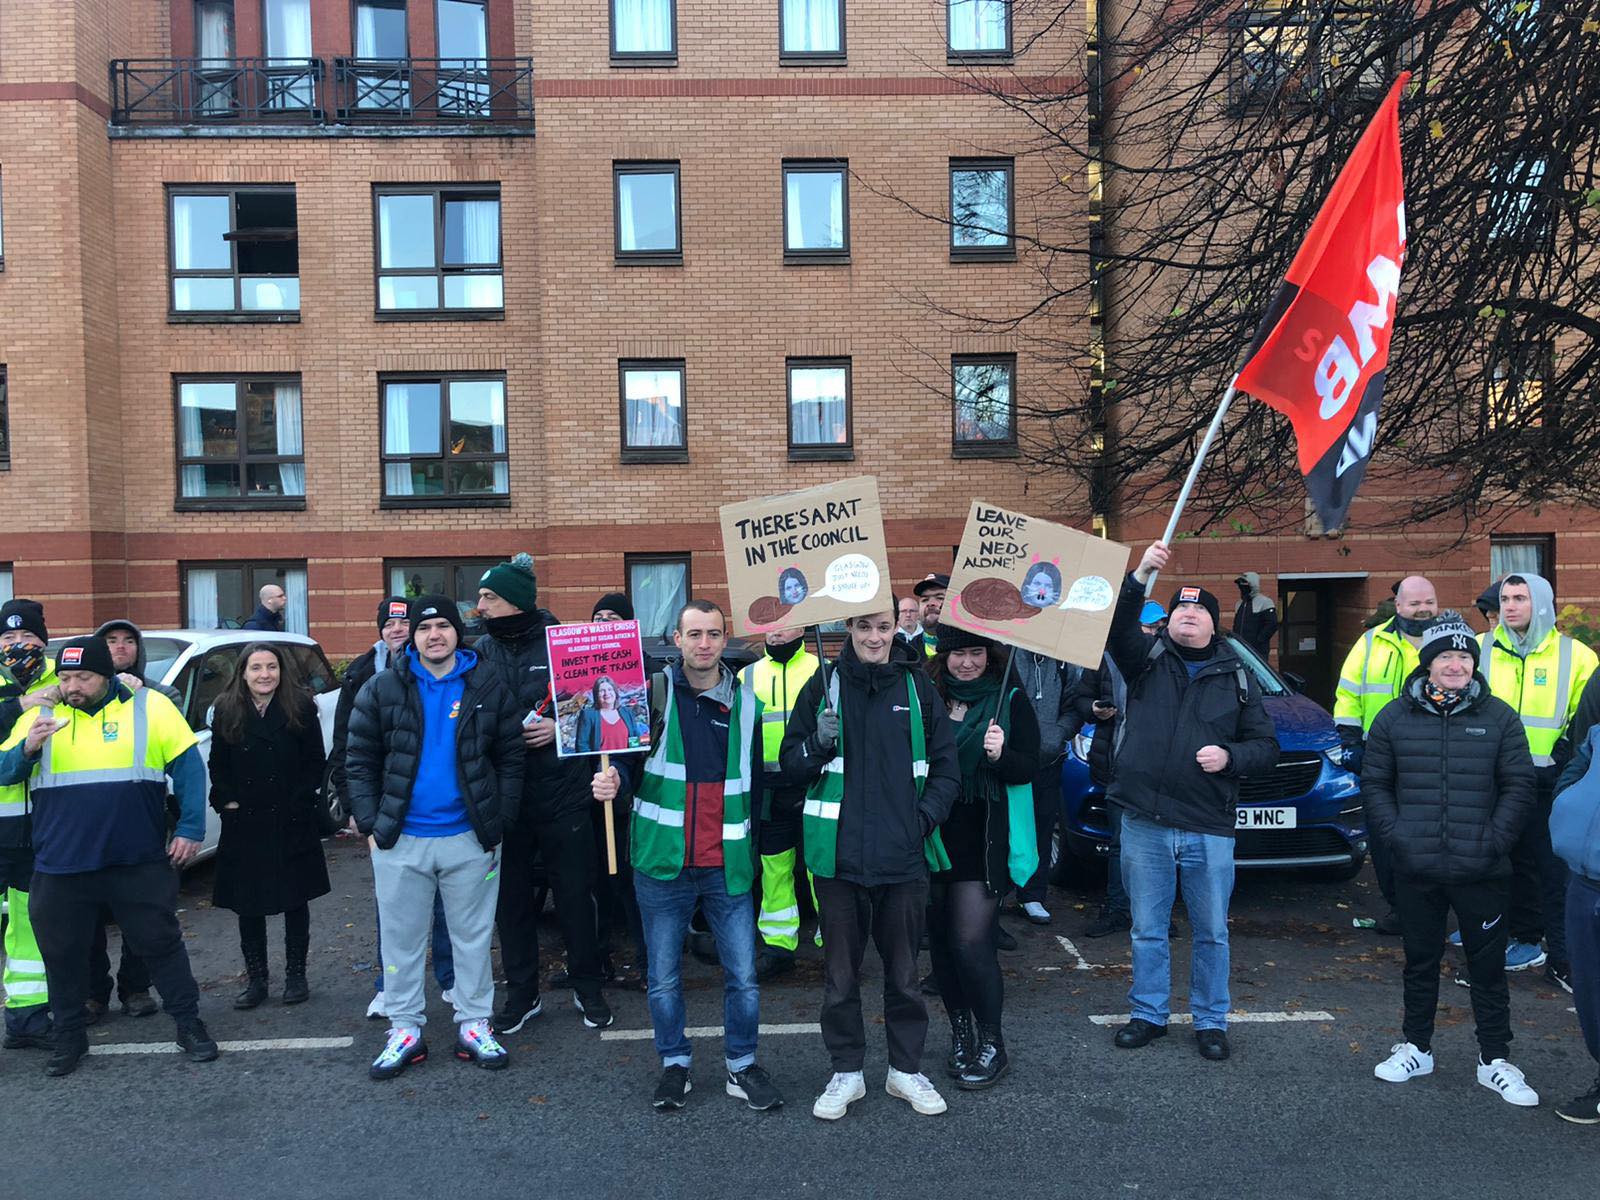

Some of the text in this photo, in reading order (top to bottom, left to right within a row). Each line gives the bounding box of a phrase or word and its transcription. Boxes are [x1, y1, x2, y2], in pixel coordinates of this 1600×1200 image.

[735, 498, 862, 540] THERE'S A RAT
[976, 506, 1027, 531] LEAVE
[979, 526, 1015, 540] OUR
[745, 544, 766, 566] IN
[767, 535, 800, 558] THE
[980, 541, 1029, 559] NEDS
[962, 555, 1015, 571] ALONE!
[550, 621, 636, 637] GLASGOW'S WASTE CRISIS
[561, 649, 632, 668] INVEST THE CASH
[563, 667, 588, 680] CLEAN
[591, 664, 607, 675] THE
[1253, 810, 1285, 825] WNC
